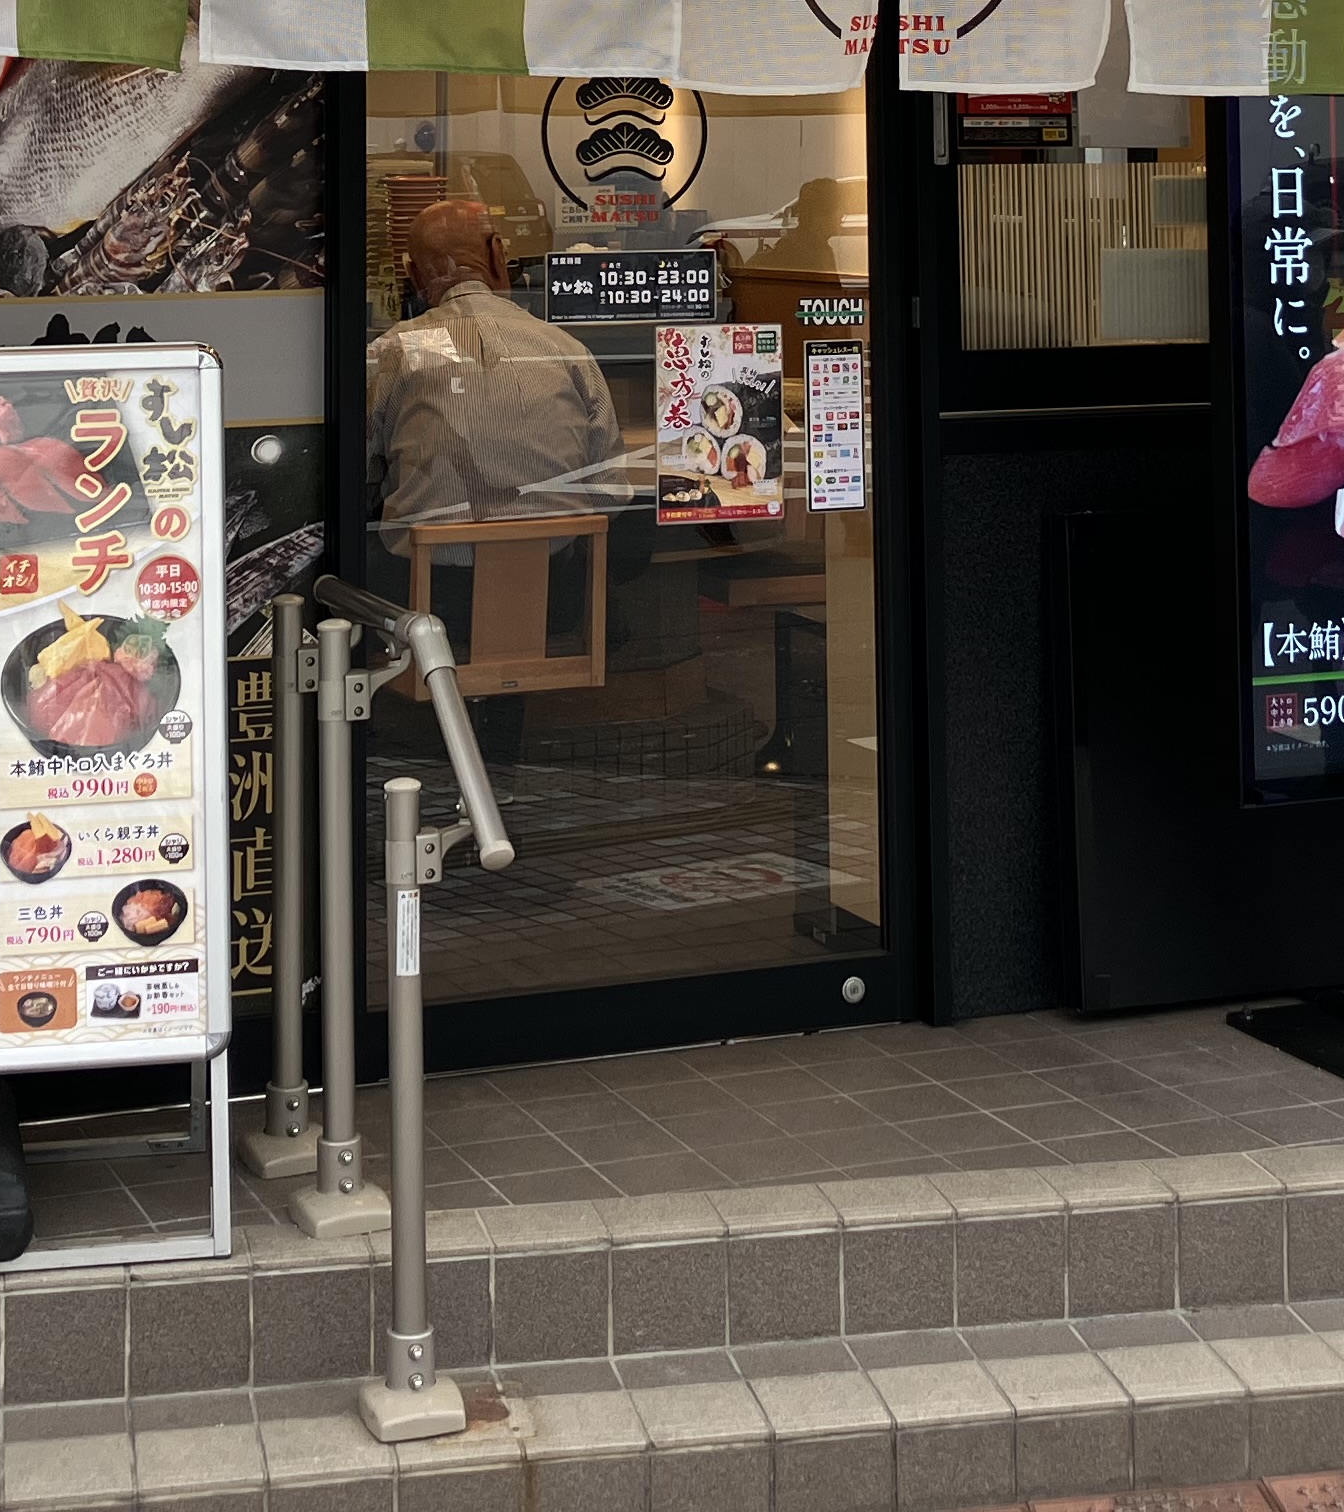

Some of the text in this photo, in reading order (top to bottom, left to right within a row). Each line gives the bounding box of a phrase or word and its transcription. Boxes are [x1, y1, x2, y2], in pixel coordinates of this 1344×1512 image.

[595, 194, 657, 206] SUSHI
[592, 210, 661, 223] MATSU
[599, 269, 709, 286] 10:30~23:00
[551, 279, 594, 296] すし松
[607, 289, 710, 304] 10:30~24:00
[799, 298, 863, 326] TOUCH
[698, 335, 713, 379] すし松の
[664, 331, 694, 428] 恵方巻
[71, 410, 131, 594] ランチ
[156, 564, 180, 578] 平日
[10, 751, 173, 778] 本鮪中トロ入まぐろ丼
[78, 824, 160, 841] いくら親子丼
[17, 905, 64, 921] 三色丼
